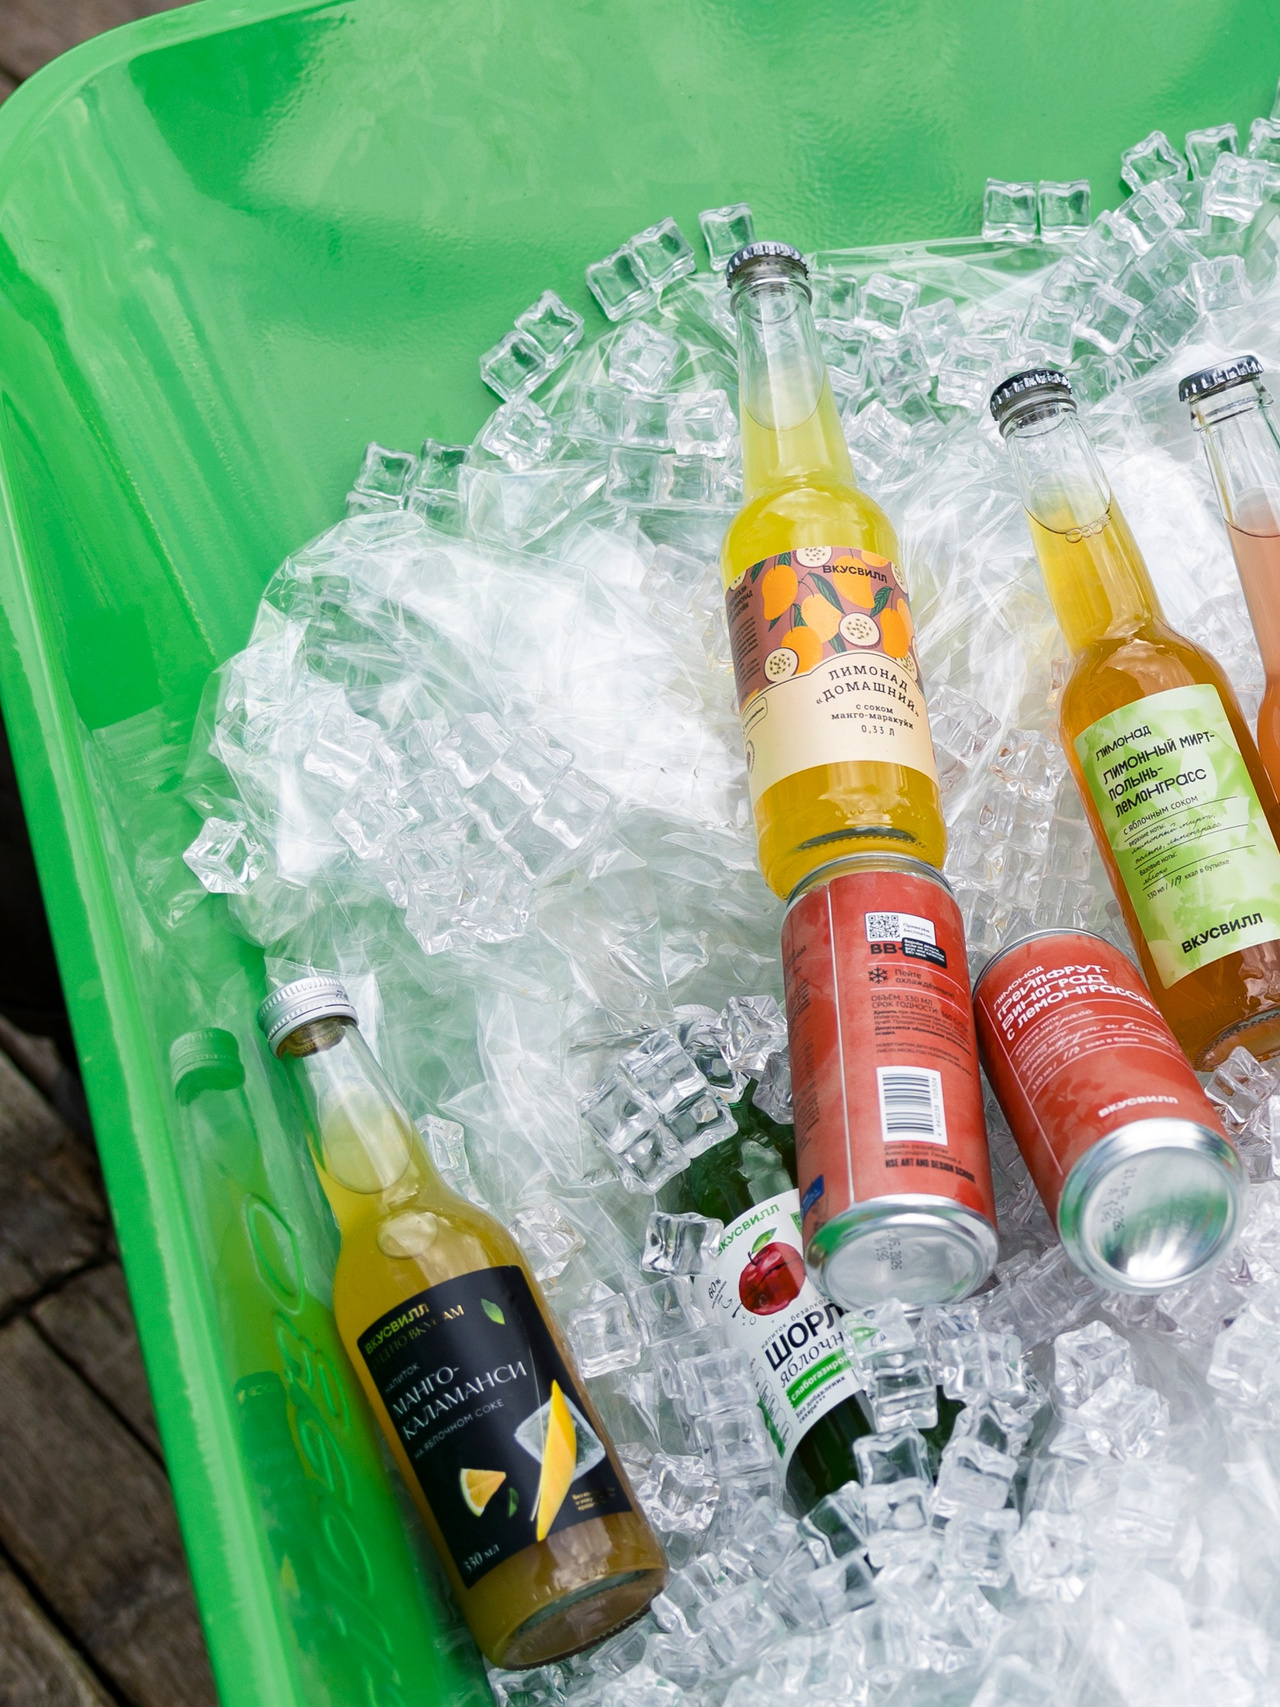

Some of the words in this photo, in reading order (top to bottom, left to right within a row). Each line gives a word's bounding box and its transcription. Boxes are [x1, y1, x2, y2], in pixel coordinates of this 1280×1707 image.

[822, 564, 888, 584] ВКУСВИЛЛ
[828, 665, 908, 693] ЛИМОНАД
[816, 681, 919, 717] «ДОМАШНИЙ»
[864, 704, 893, 714] соком
[861, 724, 885, 734] 0,33
[1181, 912, 1264, 954] ВКУСВИЛЛ
[895, 968, 922, 979] Пейте
[1098, 1095, 1178, 1118] ВКУСВИЛЛ
[901, 1158, 914, 1167] ART
[365, 1303, 430, 1355] ВКУСВИЛЛ
[761, 1323, 788, 1350] напиток
[791, 1298, 830, 1321] безалког
[765, 1302, 846, 1372] ШОРЛ
[780, 1331, 844, 1388] яблочн
[392, 1366, 459, 1418] МАНГО-
[403, 1361, 527, 1440] КАЛАМАНСИ
[424, 1413, 473, 1452] ЯБЛОЧНОМ
[475, 1398, 504, 1417] СОКЕ
